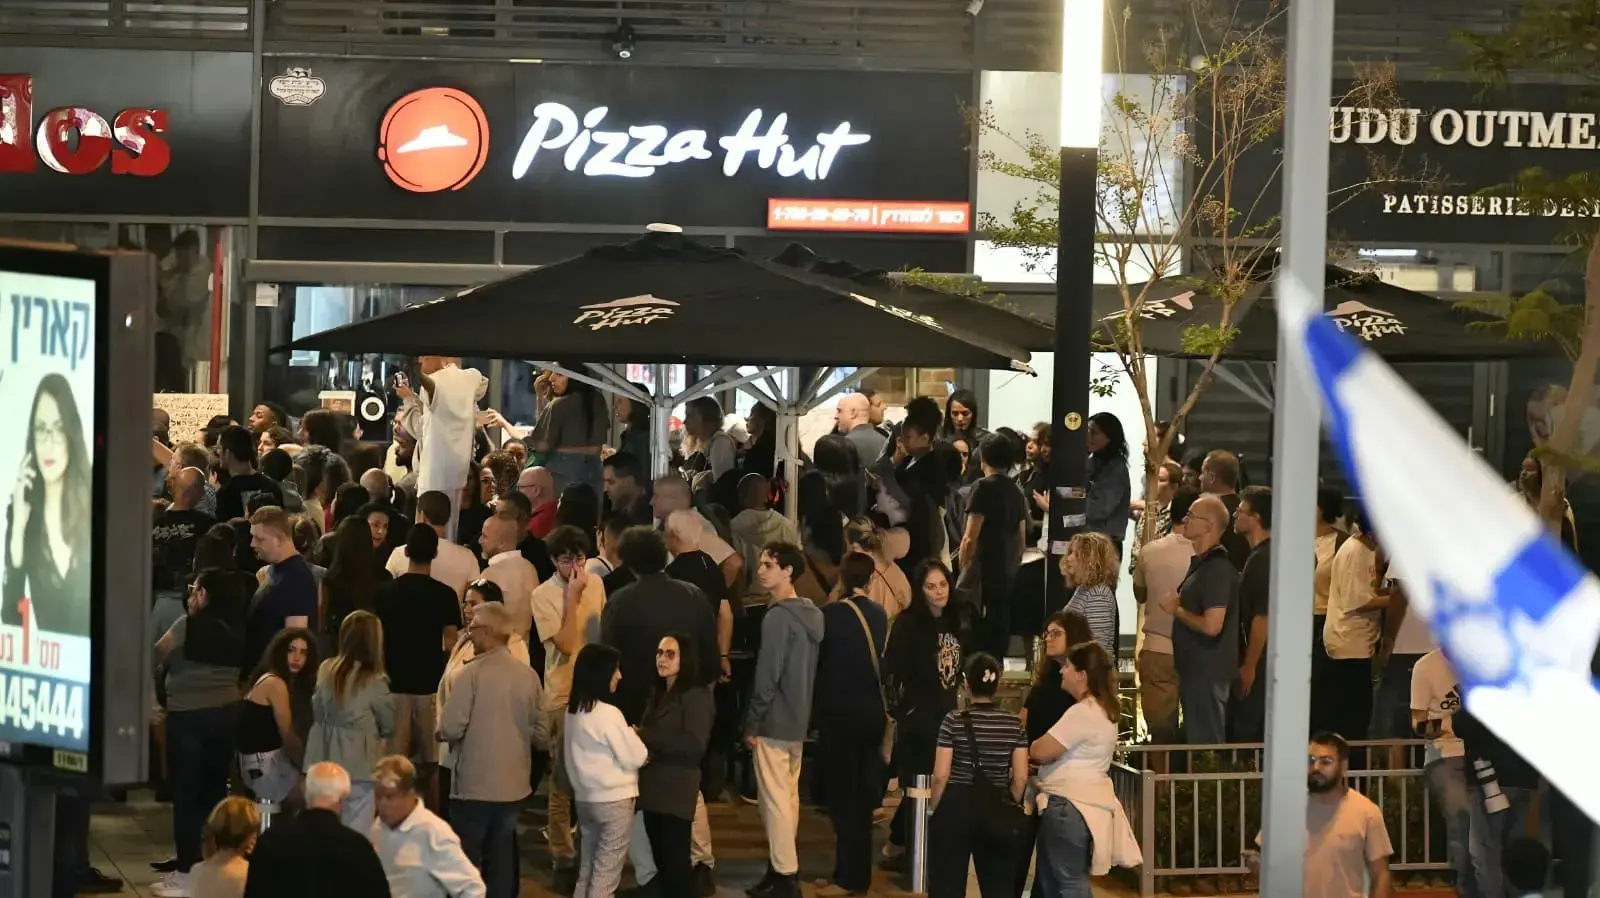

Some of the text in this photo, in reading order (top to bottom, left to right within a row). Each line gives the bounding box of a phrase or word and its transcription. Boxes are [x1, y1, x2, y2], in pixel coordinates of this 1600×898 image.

[512, 102, 871, 181] Pizza Hut
[1329, 106, 1600, 149] UDU OUTME
[10, 293, 90, 371] קארין
[573, 307, 675, 331] Pizza Hut
[1332, 313, 1409, 341] Pizza Hut
